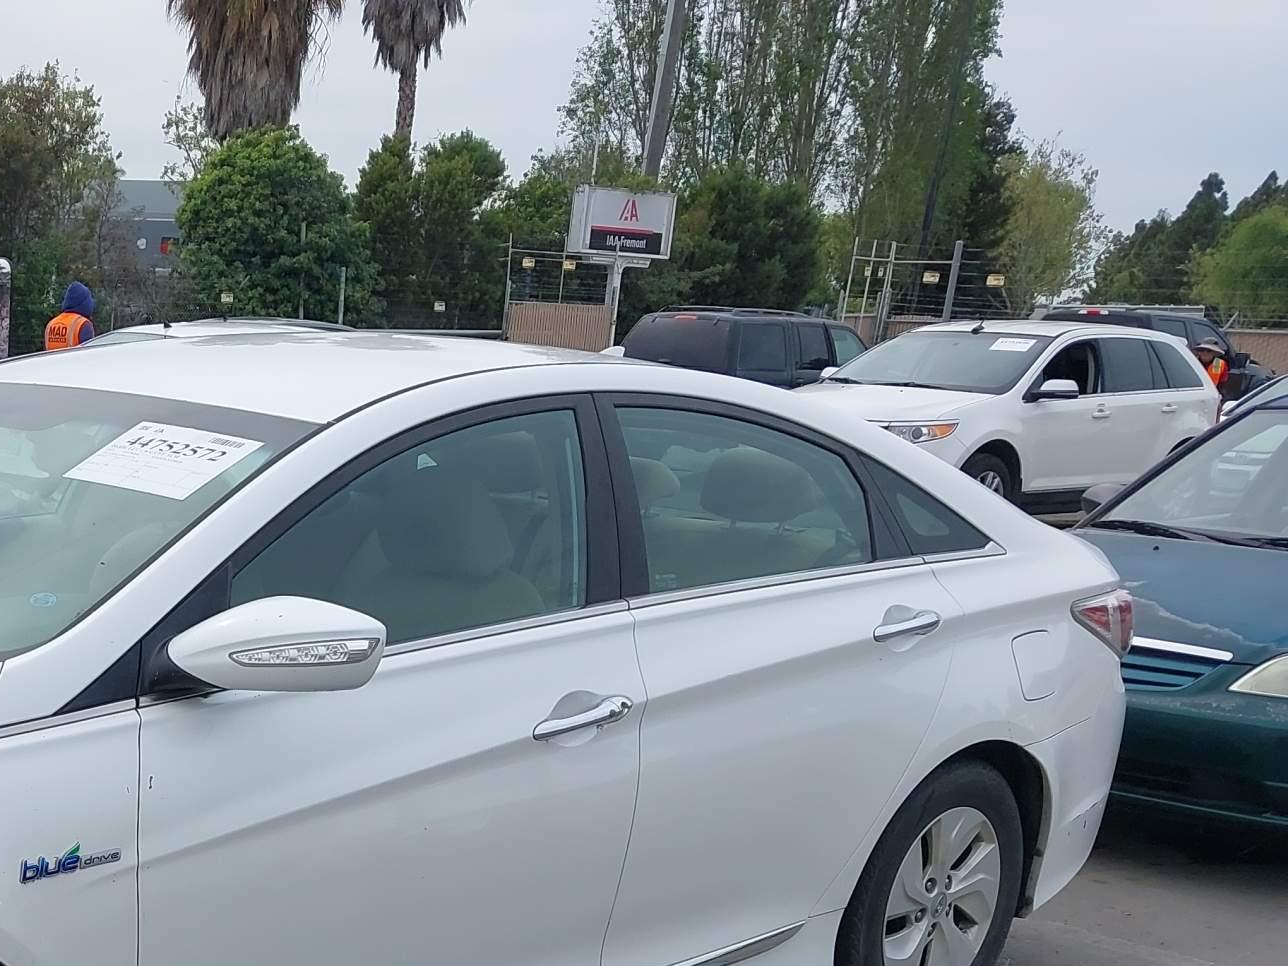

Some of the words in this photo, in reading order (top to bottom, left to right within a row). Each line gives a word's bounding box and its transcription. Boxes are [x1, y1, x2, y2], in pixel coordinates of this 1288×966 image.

[606, 234, 620, 247] IAA
[620, 235, 647, 249] Fremont
[126, 435, 228, 462] 44752572
[20, 850, 81, 884] blue
[83, 850, 121, 867] drive
